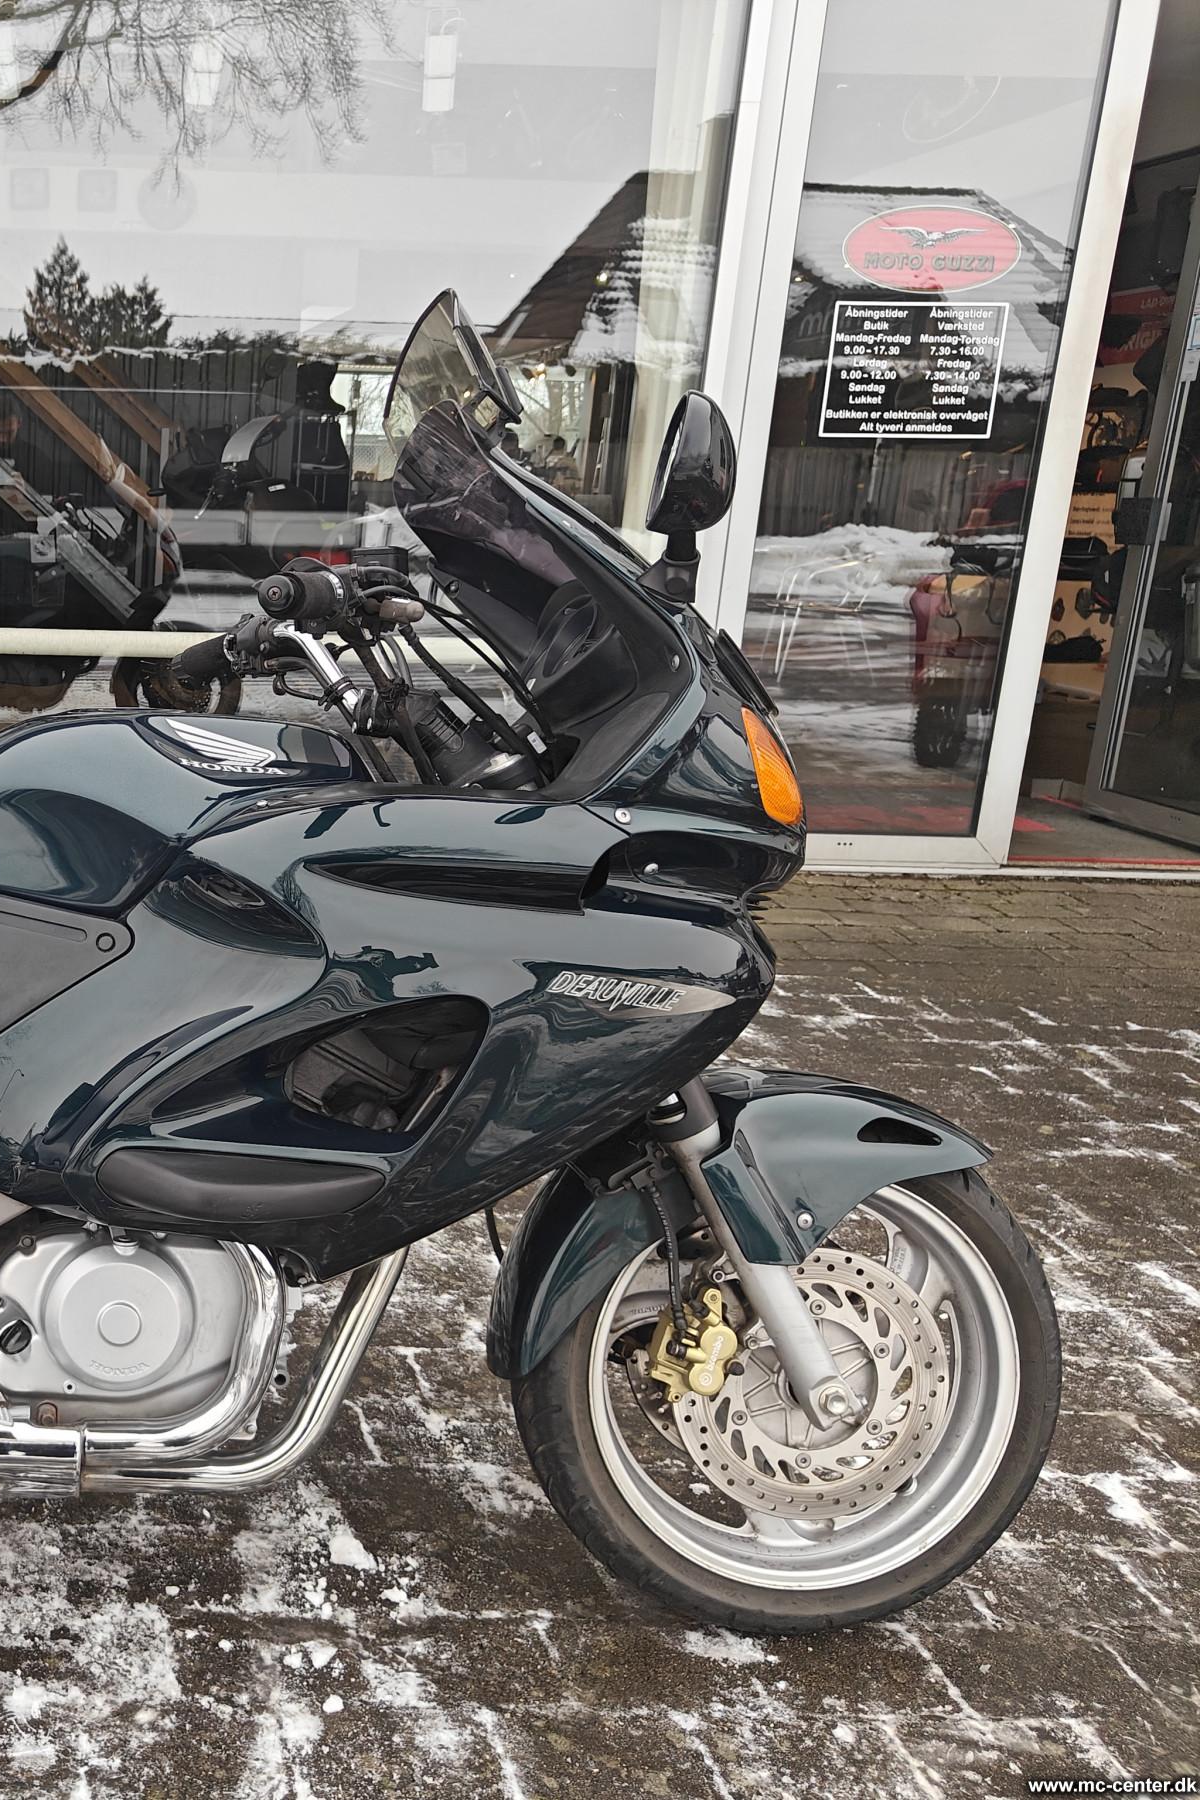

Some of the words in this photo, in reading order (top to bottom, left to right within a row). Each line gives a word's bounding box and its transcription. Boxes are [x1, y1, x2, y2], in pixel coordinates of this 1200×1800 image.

[863, 251, 924, 271] MOTO
[931, 253, 996, 273] GUZZI
[845, 305, 909, 320] Åbningstider
[929, 306, 994, 321] Åbningstider
[863, 320, 889, 331] Butik
[937, 321, 985, 331] Værksted
[835, 332, 912, 346] Mandag-Fredag
[919, 333, 1000, 348] Mandag-Torsdag
[936, 358, 972, 371] Fredag
[848, 382, 886, 395] Søndag
[932, 383, 969, 396] Søndag
[848, 394, 883, 405] Lukket
[932, 395, 966, 406] Lukket
[825, 409, 869, 420] Butikken
[870, 411, 882, 419] er
[883, 409, 938, 420] elektronisk
[939, 410, 989, 423] overvåget
[859, 422, 875, 432] Alt
[875, 422, 904, 434] tyveri
[904, 423, 953, 433] anmeldes
[178, 757, 288, 776] HONDA
[545, 970, 688, 1013] DEAUVILLE
[707, 1335, 724, 1371] brembo
[89, 1359, 151, 1377] HONDA
